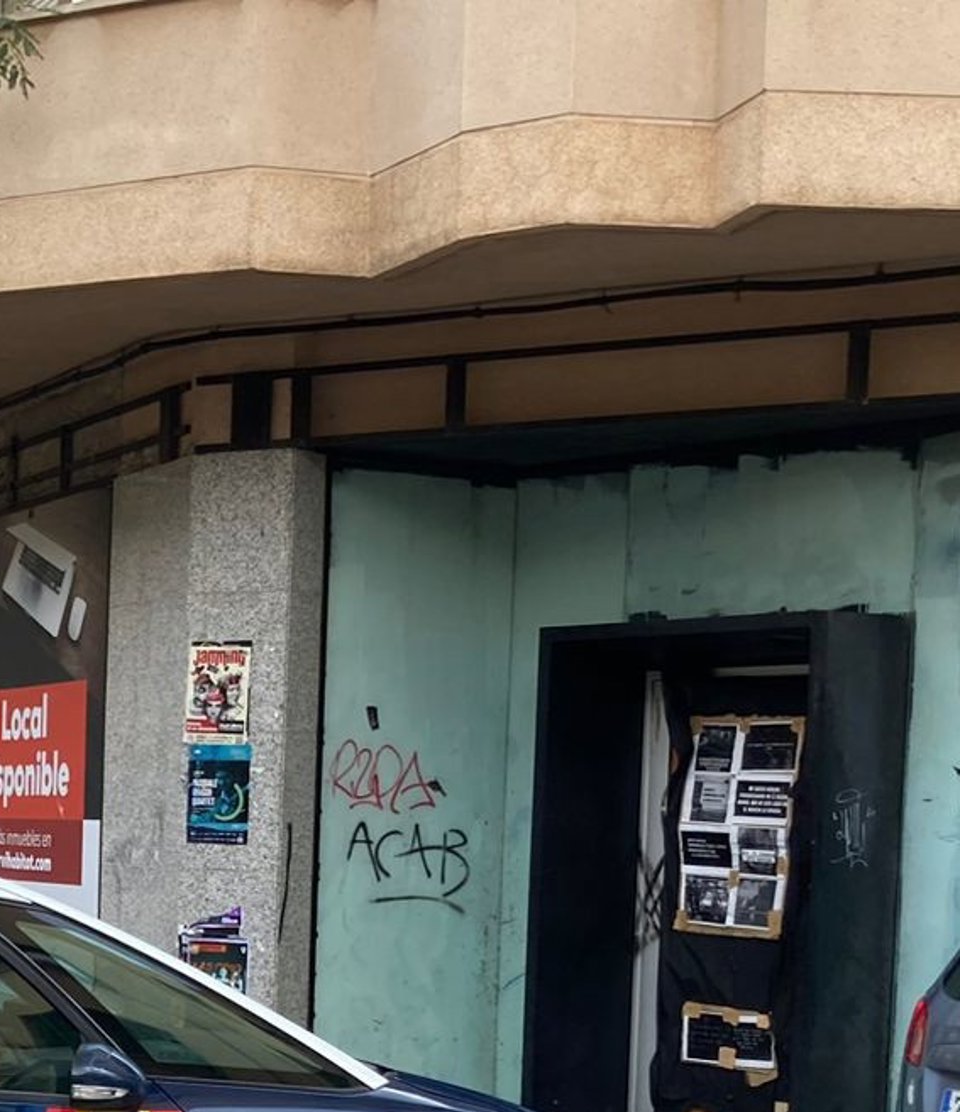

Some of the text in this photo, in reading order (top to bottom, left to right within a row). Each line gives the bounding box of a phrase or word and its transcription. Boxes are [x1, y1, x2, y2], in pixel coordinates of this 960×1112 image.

[1, 692, 49, 741] Local
[42, 833, 52, 847] en
[346, 820, 471, 898] ACAB
